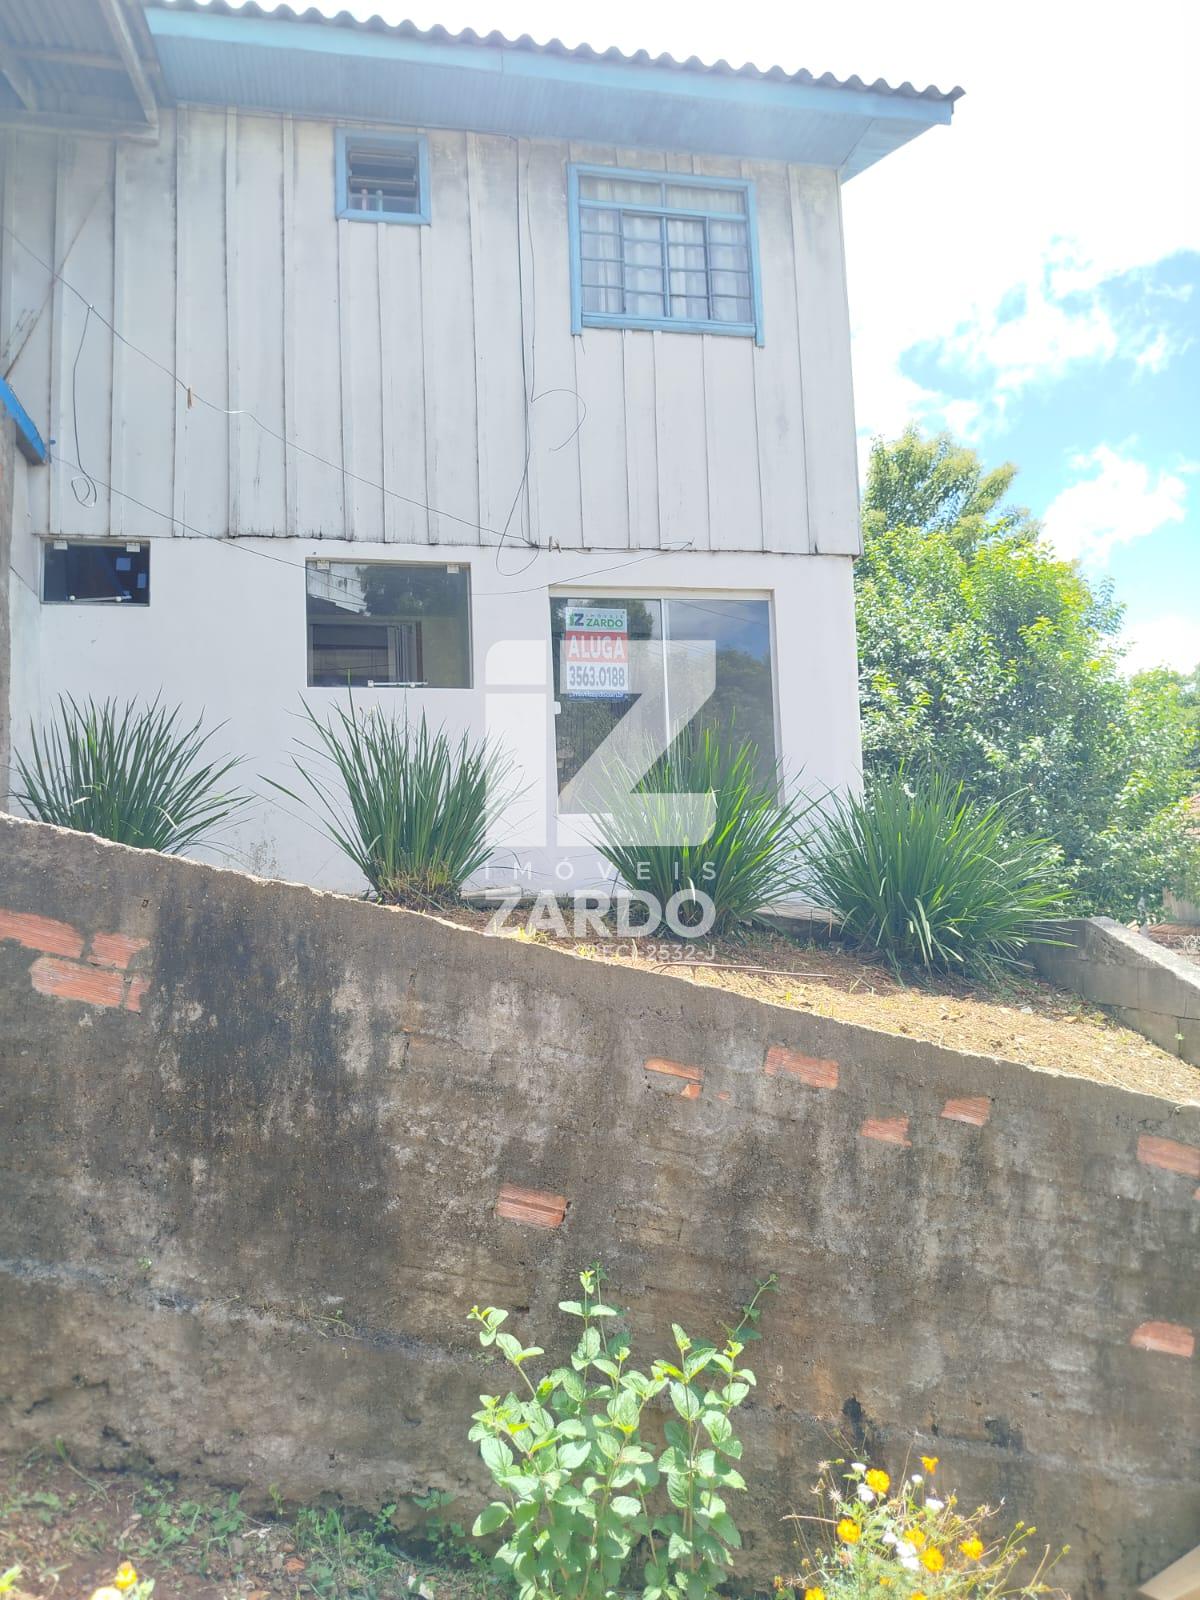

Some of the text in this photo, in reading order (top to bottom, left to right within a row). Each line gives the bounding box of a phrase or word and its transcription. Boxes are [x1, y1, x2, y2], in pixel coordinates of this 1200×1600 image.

[586, 618, 624, 628] ZARDO
[568, 635, 625, 659] ALUGA
[569, 665, 625, 687] 3563.0188
